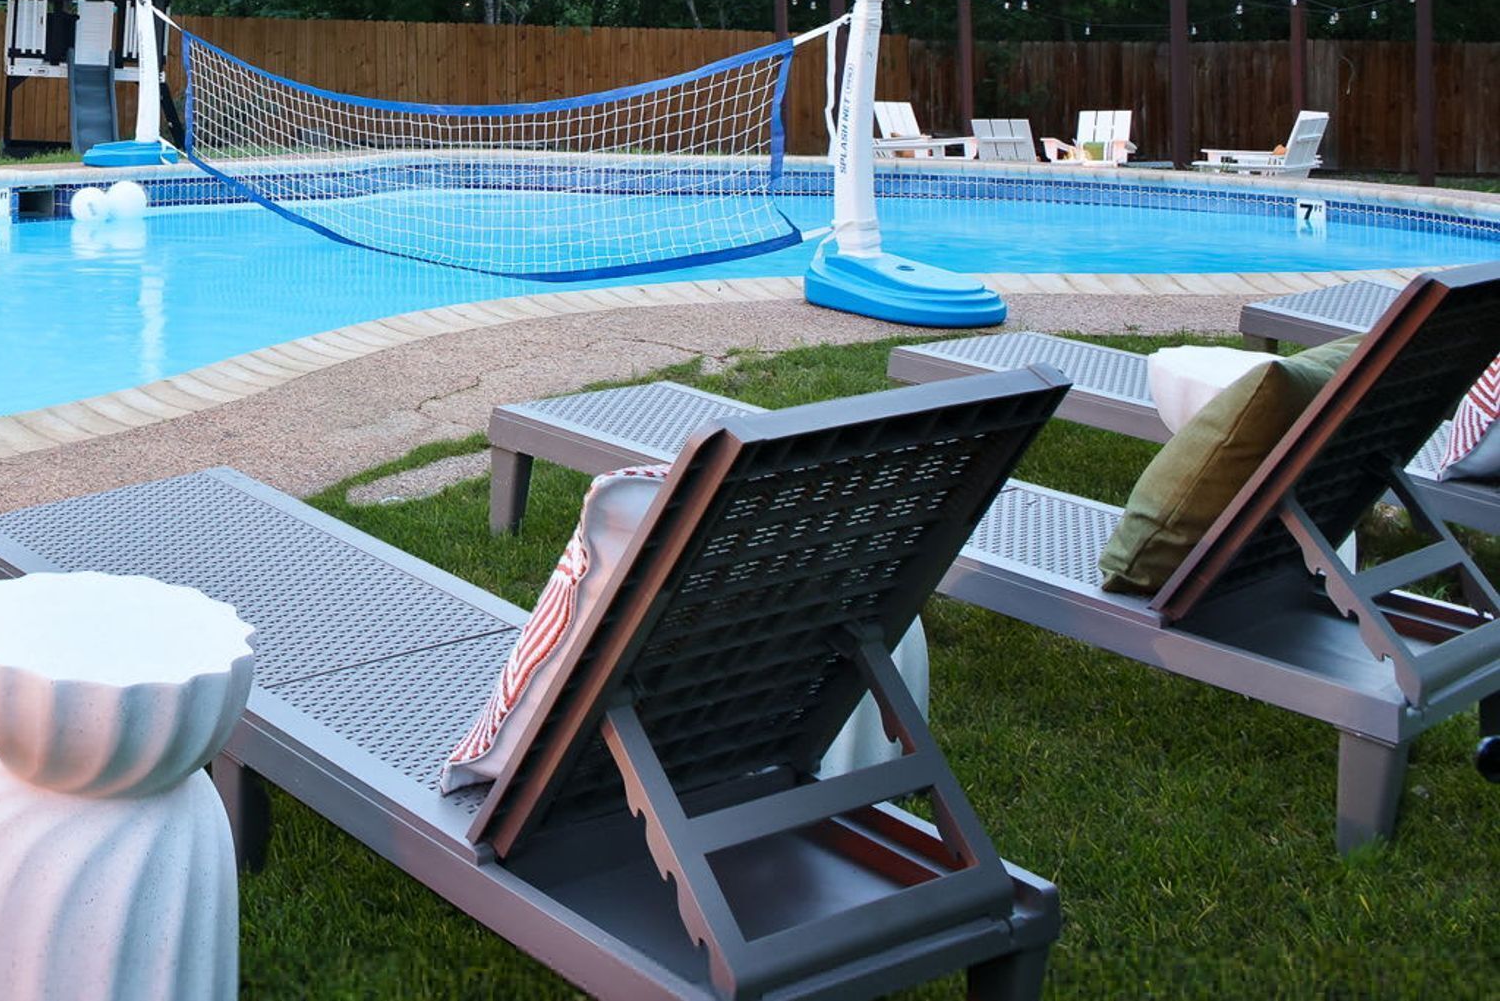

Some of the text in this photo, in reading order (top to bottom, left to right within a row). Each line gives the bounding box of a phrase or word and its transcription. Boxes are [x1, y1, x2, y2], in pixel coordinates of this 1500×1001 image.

[841, 99, 850, 122] NET
[839, 124, 848, 174] SPLASH
[1300, 203, 1313, 220] 7
